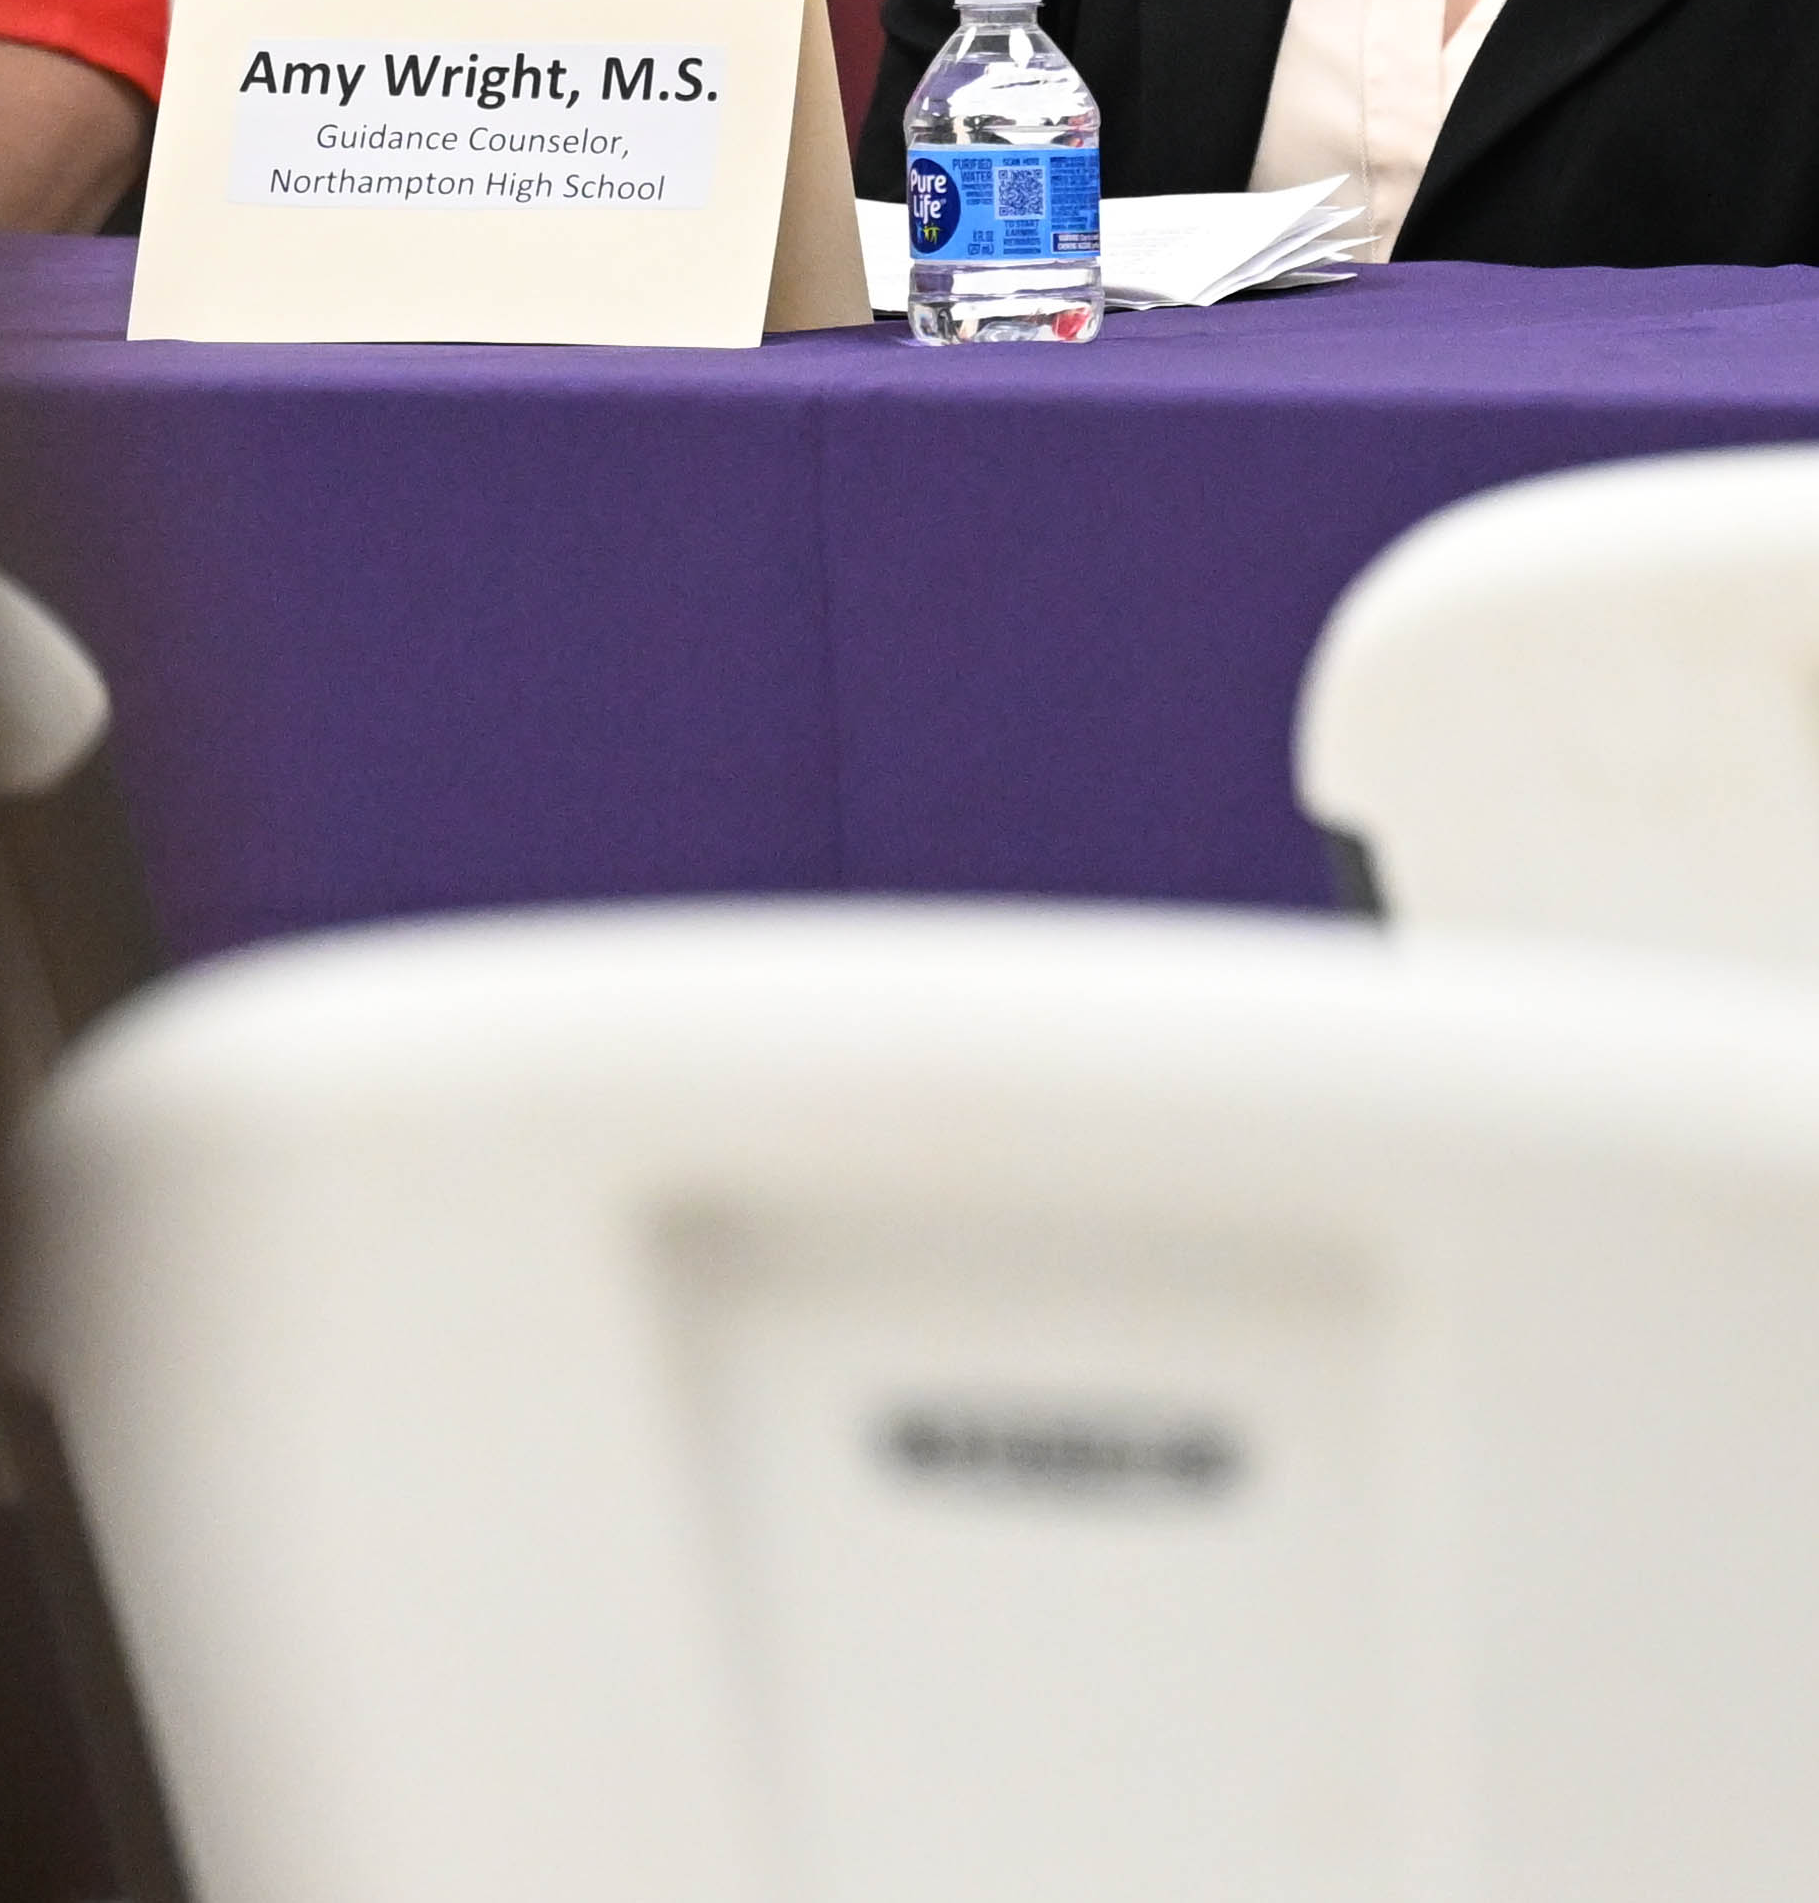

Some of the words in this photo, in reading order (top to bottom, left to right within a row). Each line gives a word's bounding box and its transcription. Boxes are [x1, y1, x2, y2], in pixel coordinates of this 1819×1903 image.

[239, 50, 367, 107] Amy
[384, 52, 580, 110] Wright,
[601, 56, 718, 102] M.S.
[316, 123, 459, 150] Guidance
[468, 126, 630, 160] Counselor,
[269, 167, 475, 201] Northampton
[485, 171, 553, 204] High
[562, 173, 666, 202] School
[910, 168, 948, 194] Pure
[913, 194, 942, 225] Life
